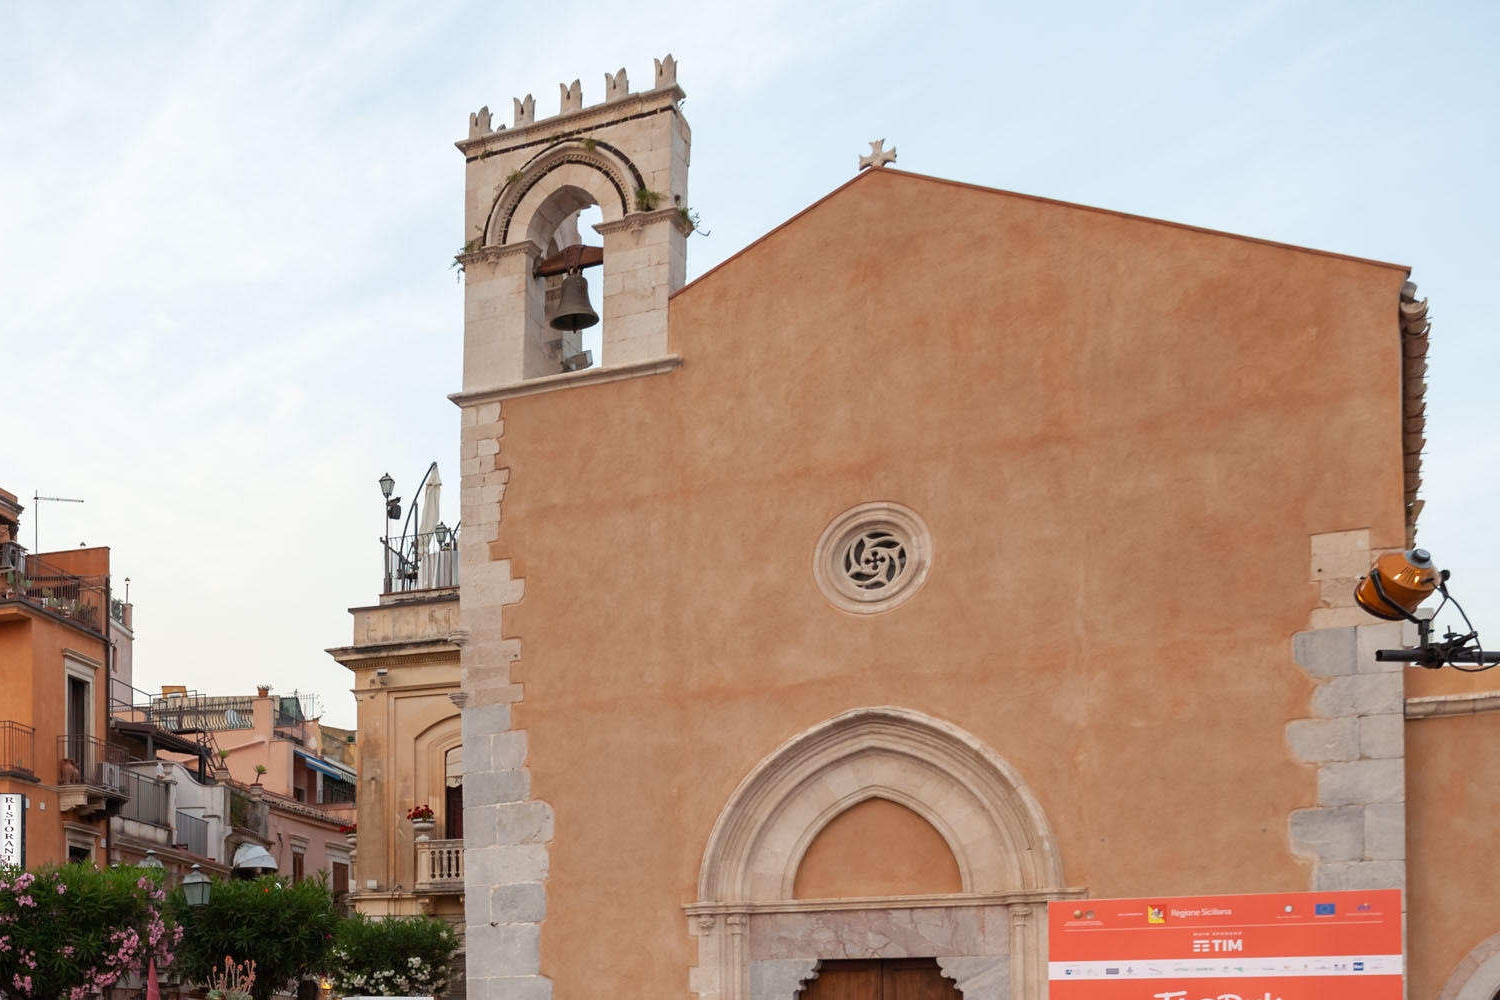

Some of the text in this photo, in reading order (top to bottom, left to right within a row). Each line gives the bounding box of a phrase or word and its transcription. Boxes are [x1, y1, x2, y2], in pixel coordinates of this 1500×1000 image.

[4, 797, 14, 862] RISTORANT
[1171, 908, 1200, 918] Regione
[1211, 939, 1243, 952] TIM
